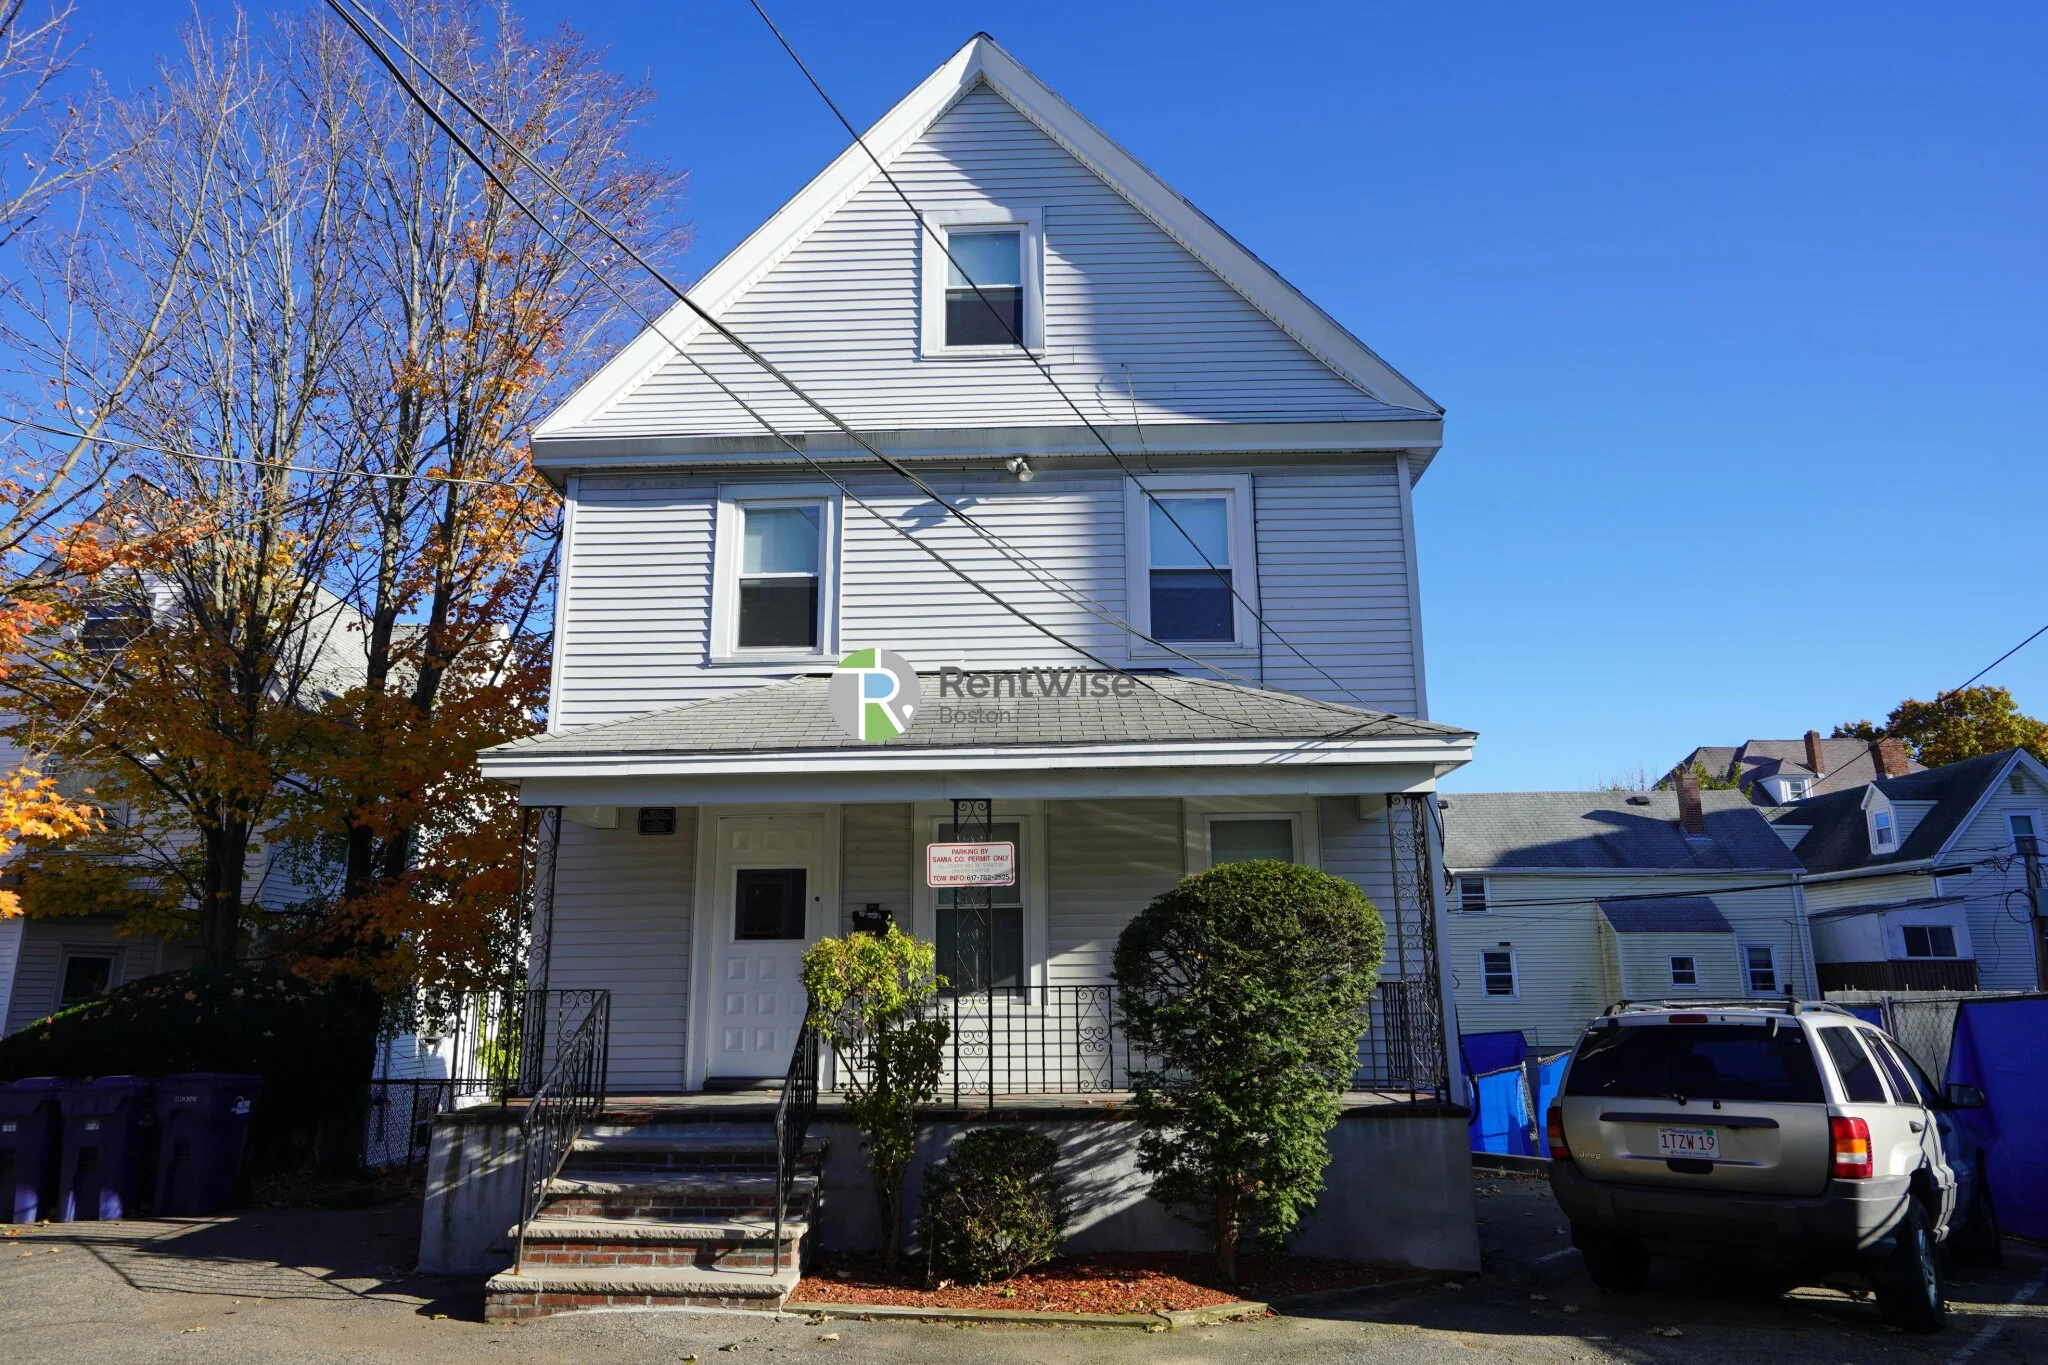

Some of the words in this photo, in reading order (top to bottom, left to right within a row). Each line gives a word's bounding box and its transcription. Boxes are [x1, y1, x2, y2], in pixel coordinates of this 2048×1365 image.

[1661, 1133, 1694, 1150] 1TZW
[1698, 1135, 1715, 1151] 19
[1580, 1151, 1602, 1160] Jeep
